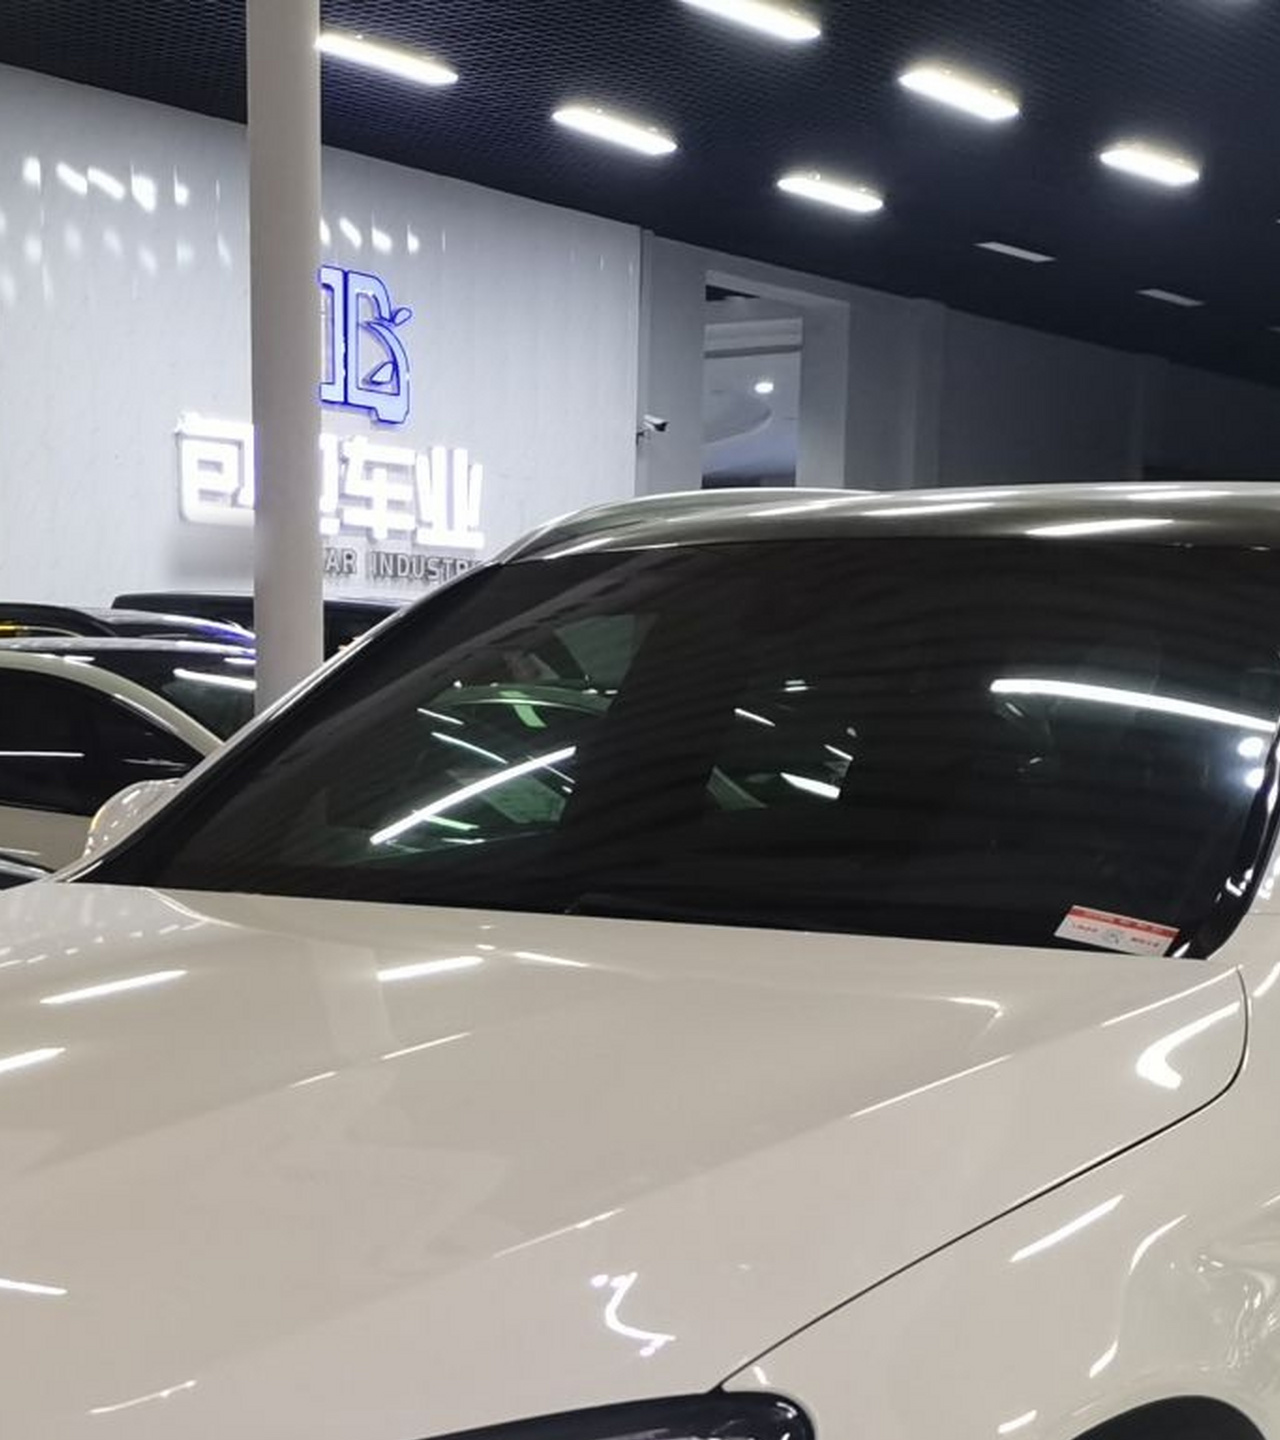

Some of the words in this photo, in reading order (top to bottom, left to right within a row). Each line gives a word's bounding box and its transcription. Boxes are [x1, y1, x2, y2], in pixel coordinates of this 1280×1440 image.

[173, 411, 485, 549] 包车业
[322, 547, 358, 575] AR
[369, 550, 483, 585] INDUSTR
